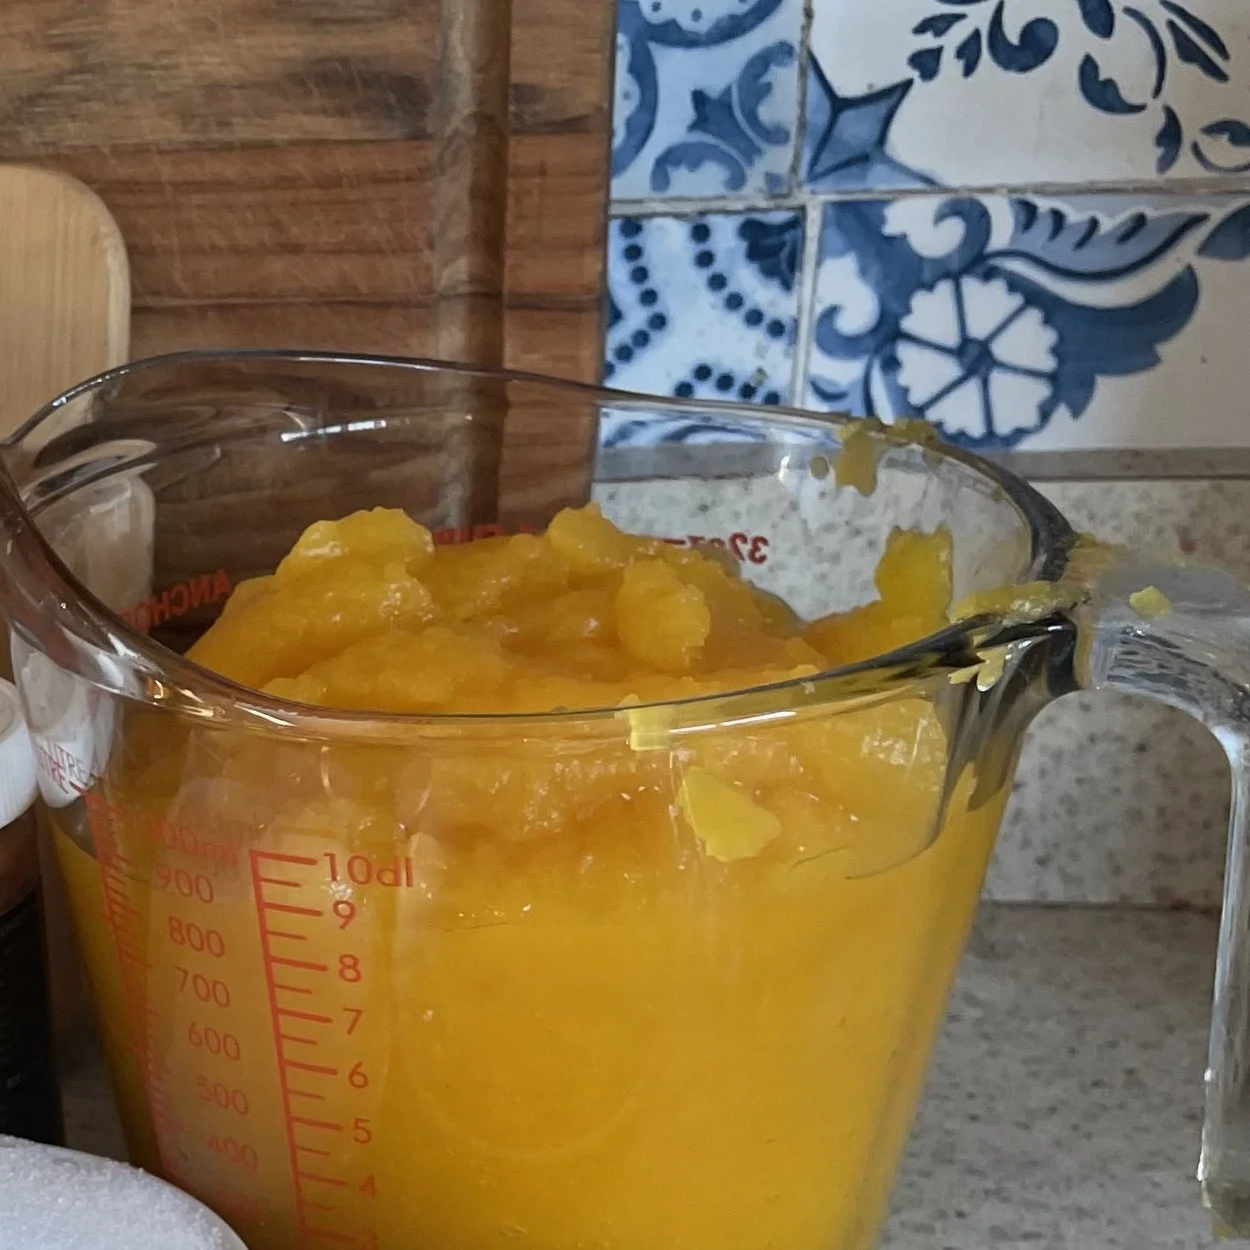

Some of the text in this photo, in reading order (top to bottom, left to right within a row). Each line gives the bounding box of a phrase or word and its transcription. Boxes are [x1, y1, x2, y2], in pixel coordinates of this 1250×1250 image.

[158, 864, 215, 904] 900
[321, 851, 414, 888] 10dl
[332, 899, 356, 929] 9
[168, 917, 225, 958] 800
[338, 955, 362, 983] 8
[174, 966, 231, 1008] 700
[345, 1008, 364, 1035] 7
[188, 1020, 241, 1061] 600
[349, 1061, 369, 1089] 6
[352, 1118, 372, 1145] 5
[358, 1173, 378, 1199] 4
